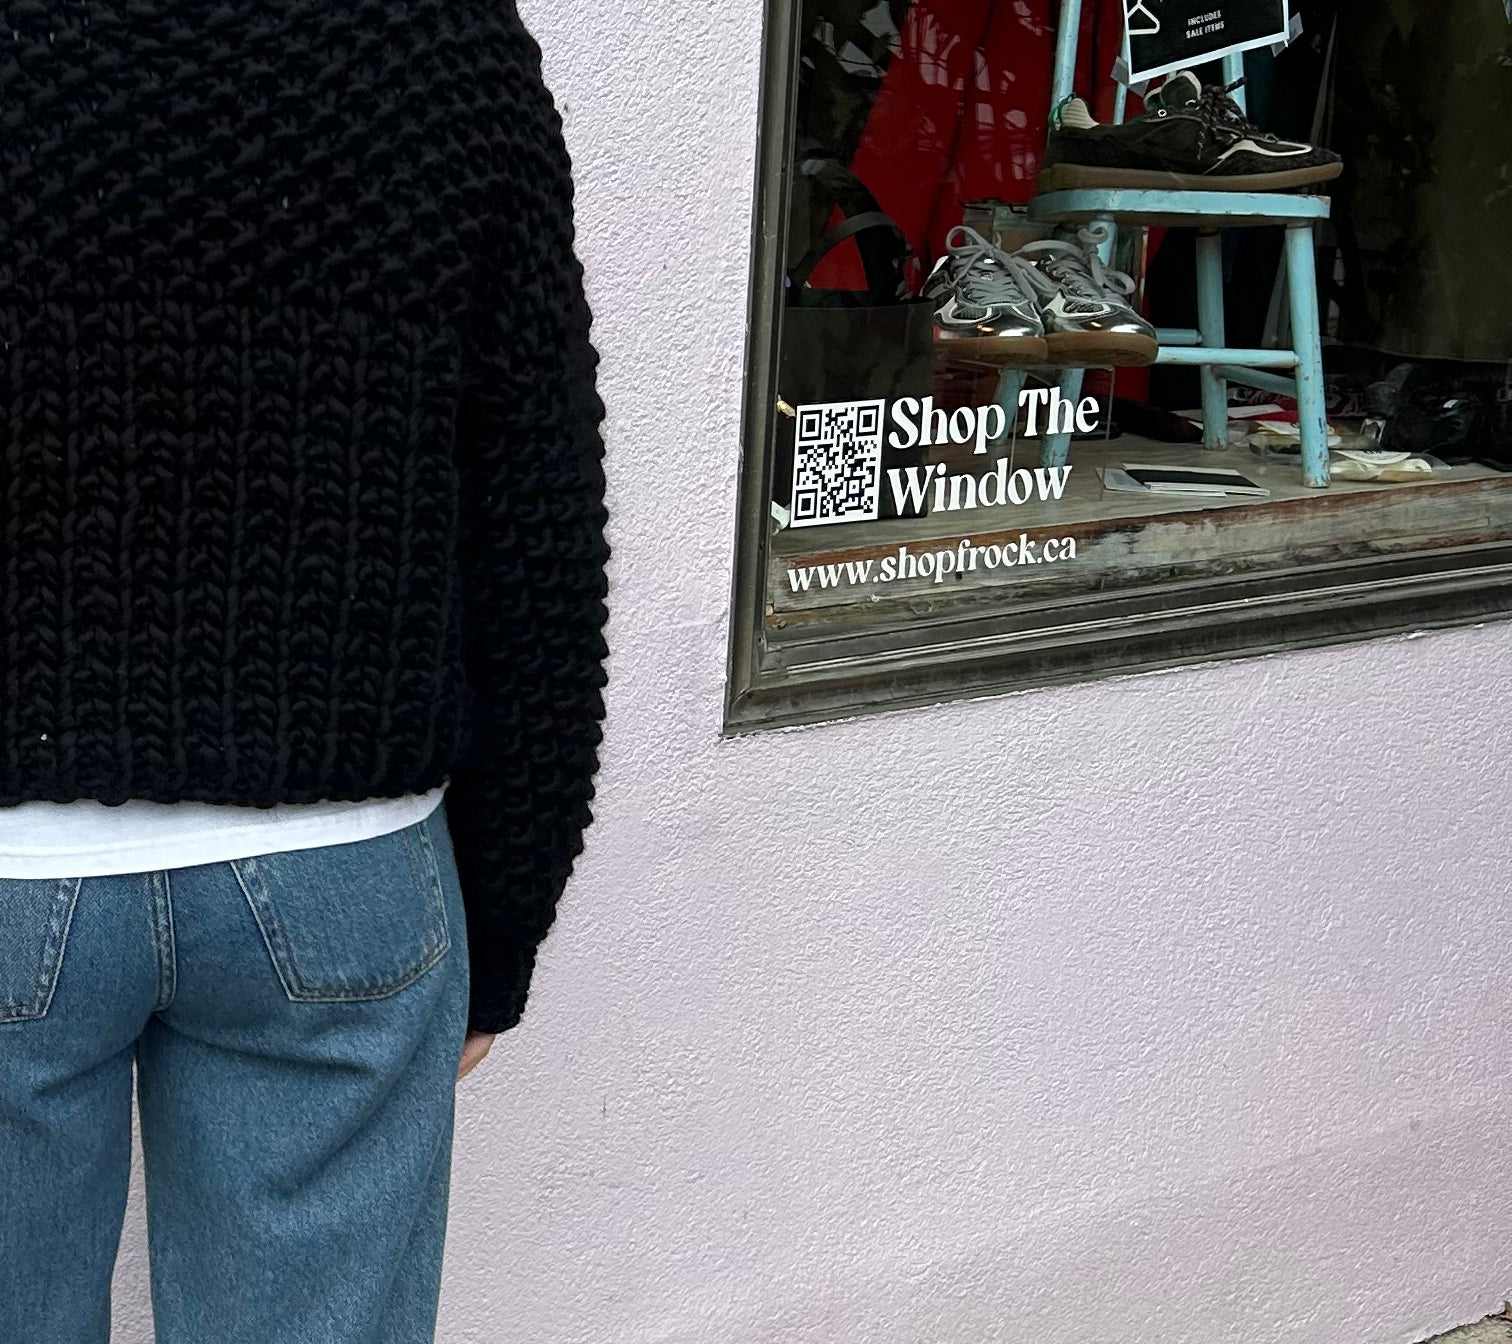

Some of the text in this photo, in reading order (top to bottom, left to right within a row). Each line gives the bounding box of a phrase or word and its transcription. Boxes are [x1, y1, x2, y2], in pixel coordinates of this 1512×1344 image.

[888, 386, 1101, 455] Shop The
[887, 458, 1073, 516] Window
[787, 533, 1077, 593] www.shopfrock.ca
